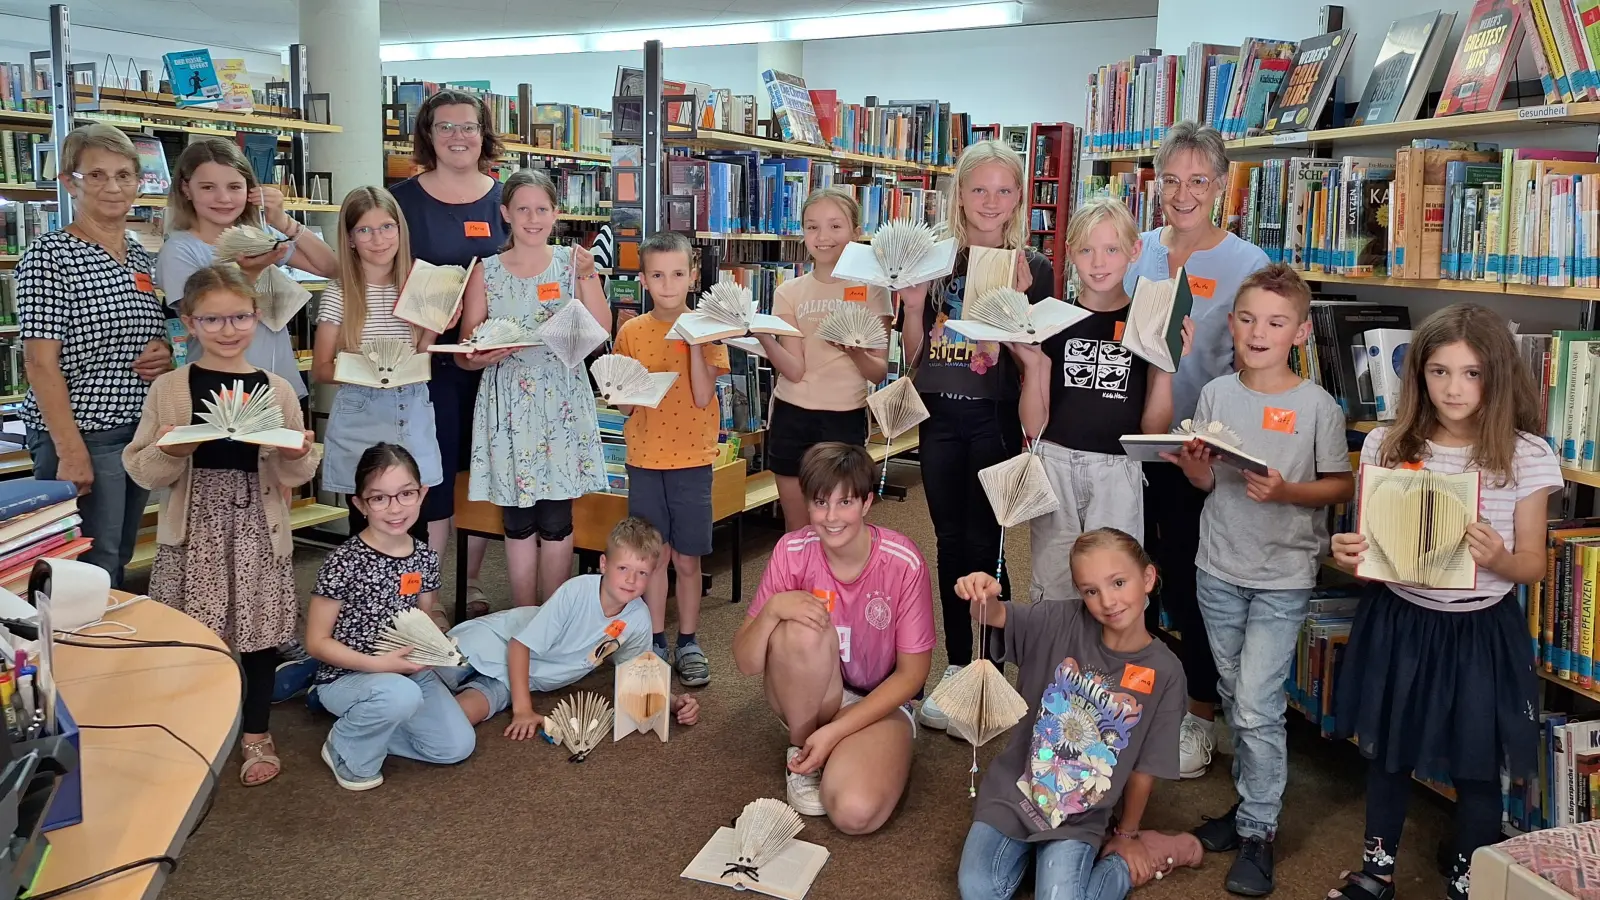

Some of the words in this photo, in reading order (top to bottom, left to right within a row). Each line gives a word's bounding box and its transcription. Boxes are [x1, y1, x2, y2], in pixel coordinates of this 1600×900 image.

[1478, 14, 1503, 28] WEBER'S
[1464, 25, 1507, 52] GREATEST
[1298, 46, 1332, 65] WEBER'S
[1379, 55, 1408, 80] KOCH
[1466, 48, 1489, 70] HITS
[1289, 60, 1324, 86] GRILL
[1279, 82, 1315, 108] BIBEL
[1370, 79, 1399, 102] BUCH
[1519, 106, 1565, 118] Gesundheit
[1348, 189, 1356, 225] KATZEN
[1568, 768, 1576, 817] Körpersprache
